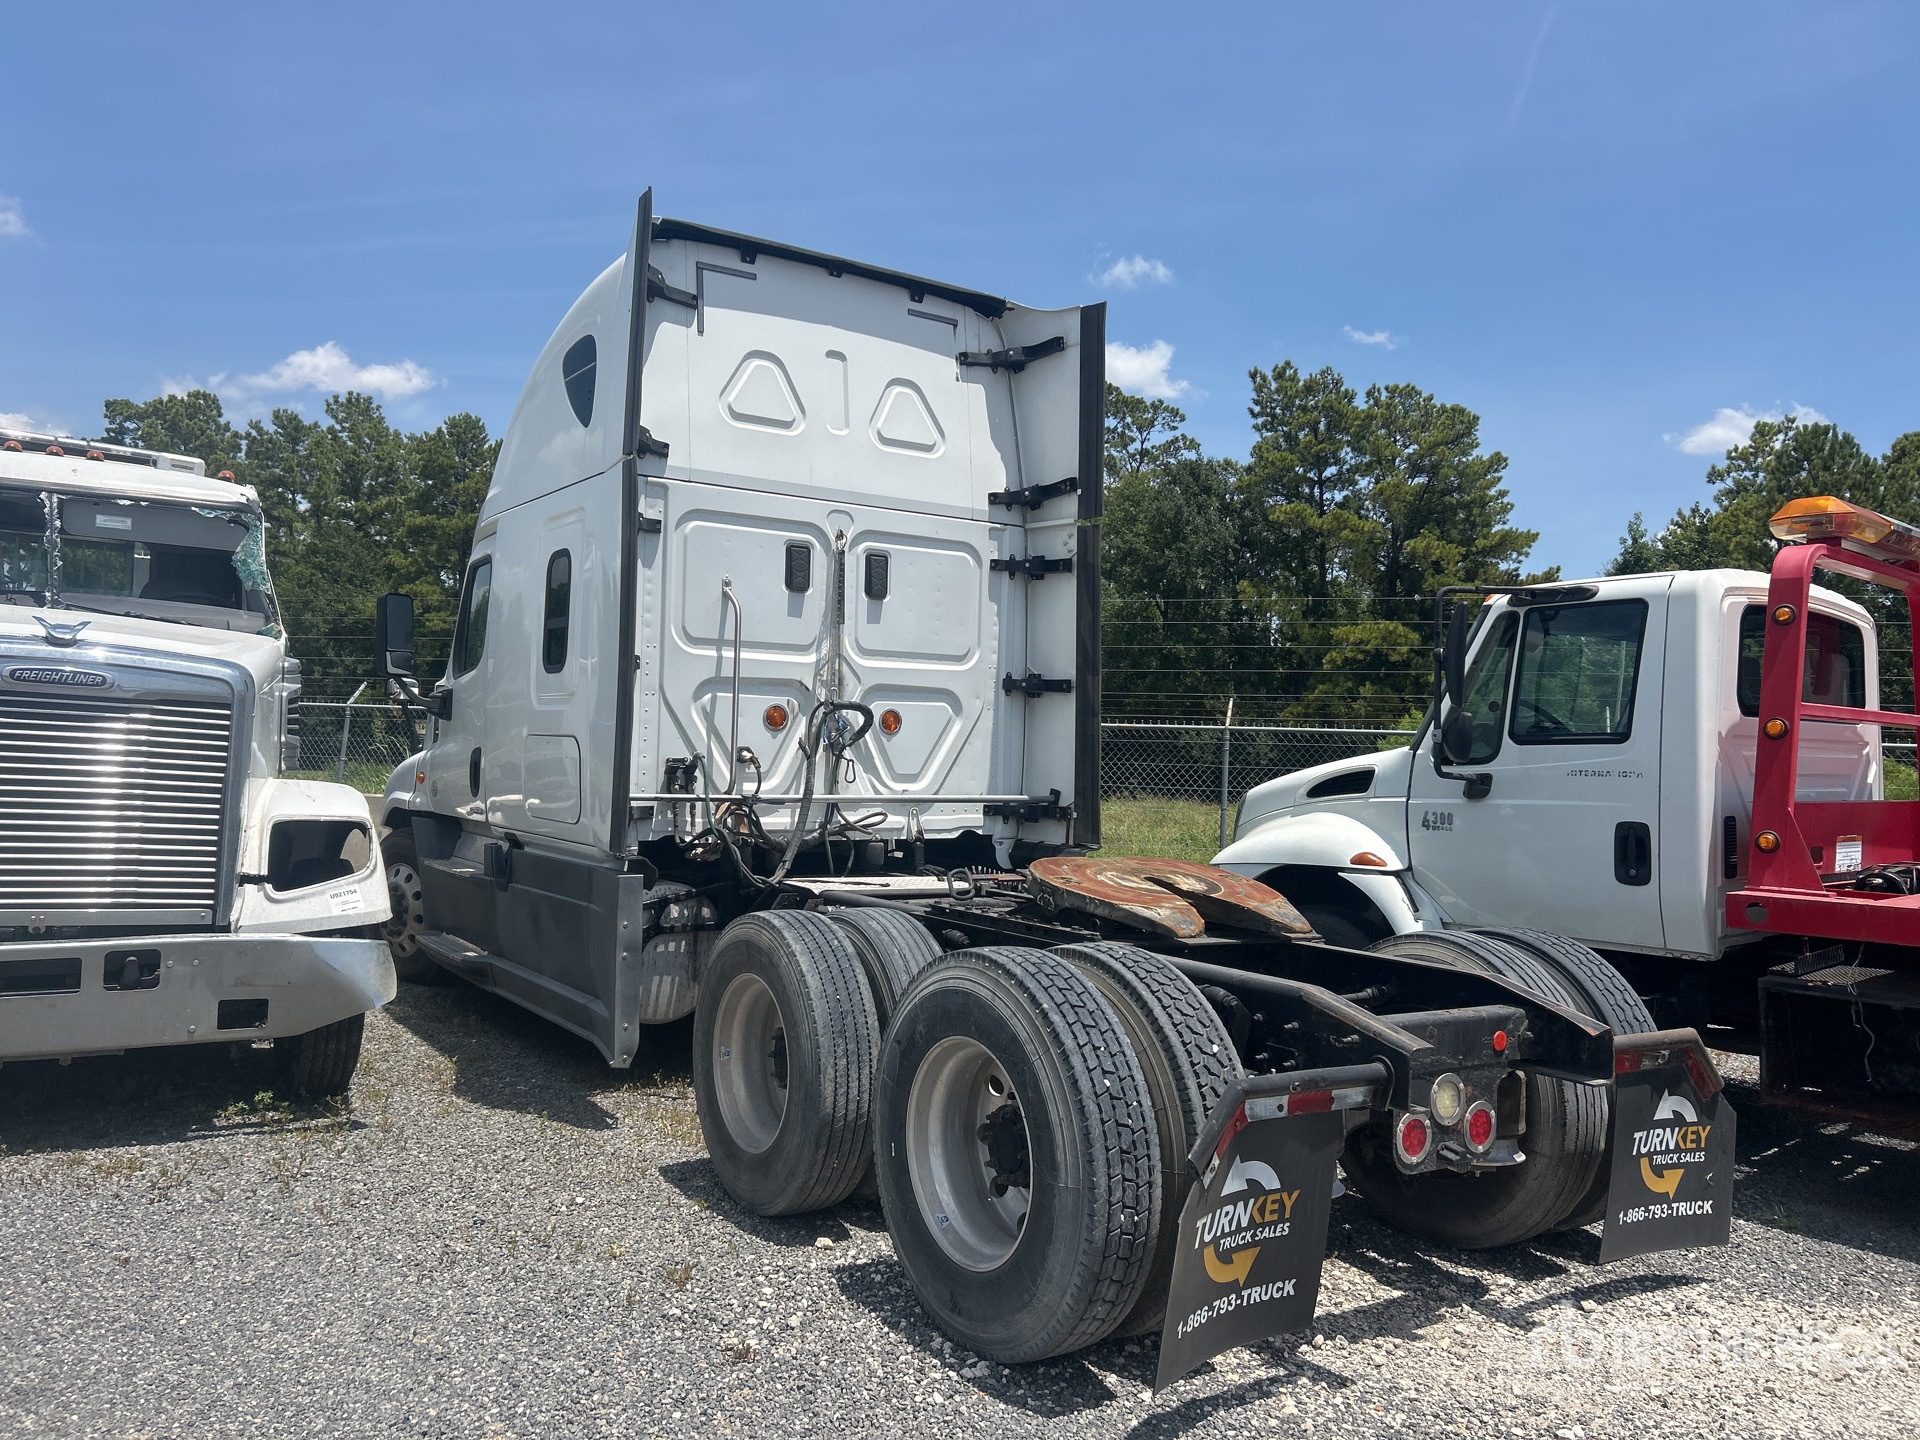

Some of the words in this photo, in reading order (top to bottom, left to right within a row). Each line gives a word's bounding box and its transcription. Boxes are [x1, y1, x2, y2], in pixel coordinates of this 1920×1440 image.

[14, 671, 103, 685] FREIGHTLINER
[1421, 811, 1454, 830] 4300
[1632, 1125, 1712, 1156] TURNKEY
[1652, 1153, 1679, 1166] TRUCK
[1679, 1151, 1706, 1162] SALES
[1194, 1189, 1301, 1250] TURNKEY
[1618, 1200, 1714, 1226] 1-866-793-TRUCK
[1219, 1229, 1254, 1252] TRUCK
[1254, 1222, 1291, 1241] SALES
[1176, 1278, 1297, 1339] 1-866-793-TRUCK
